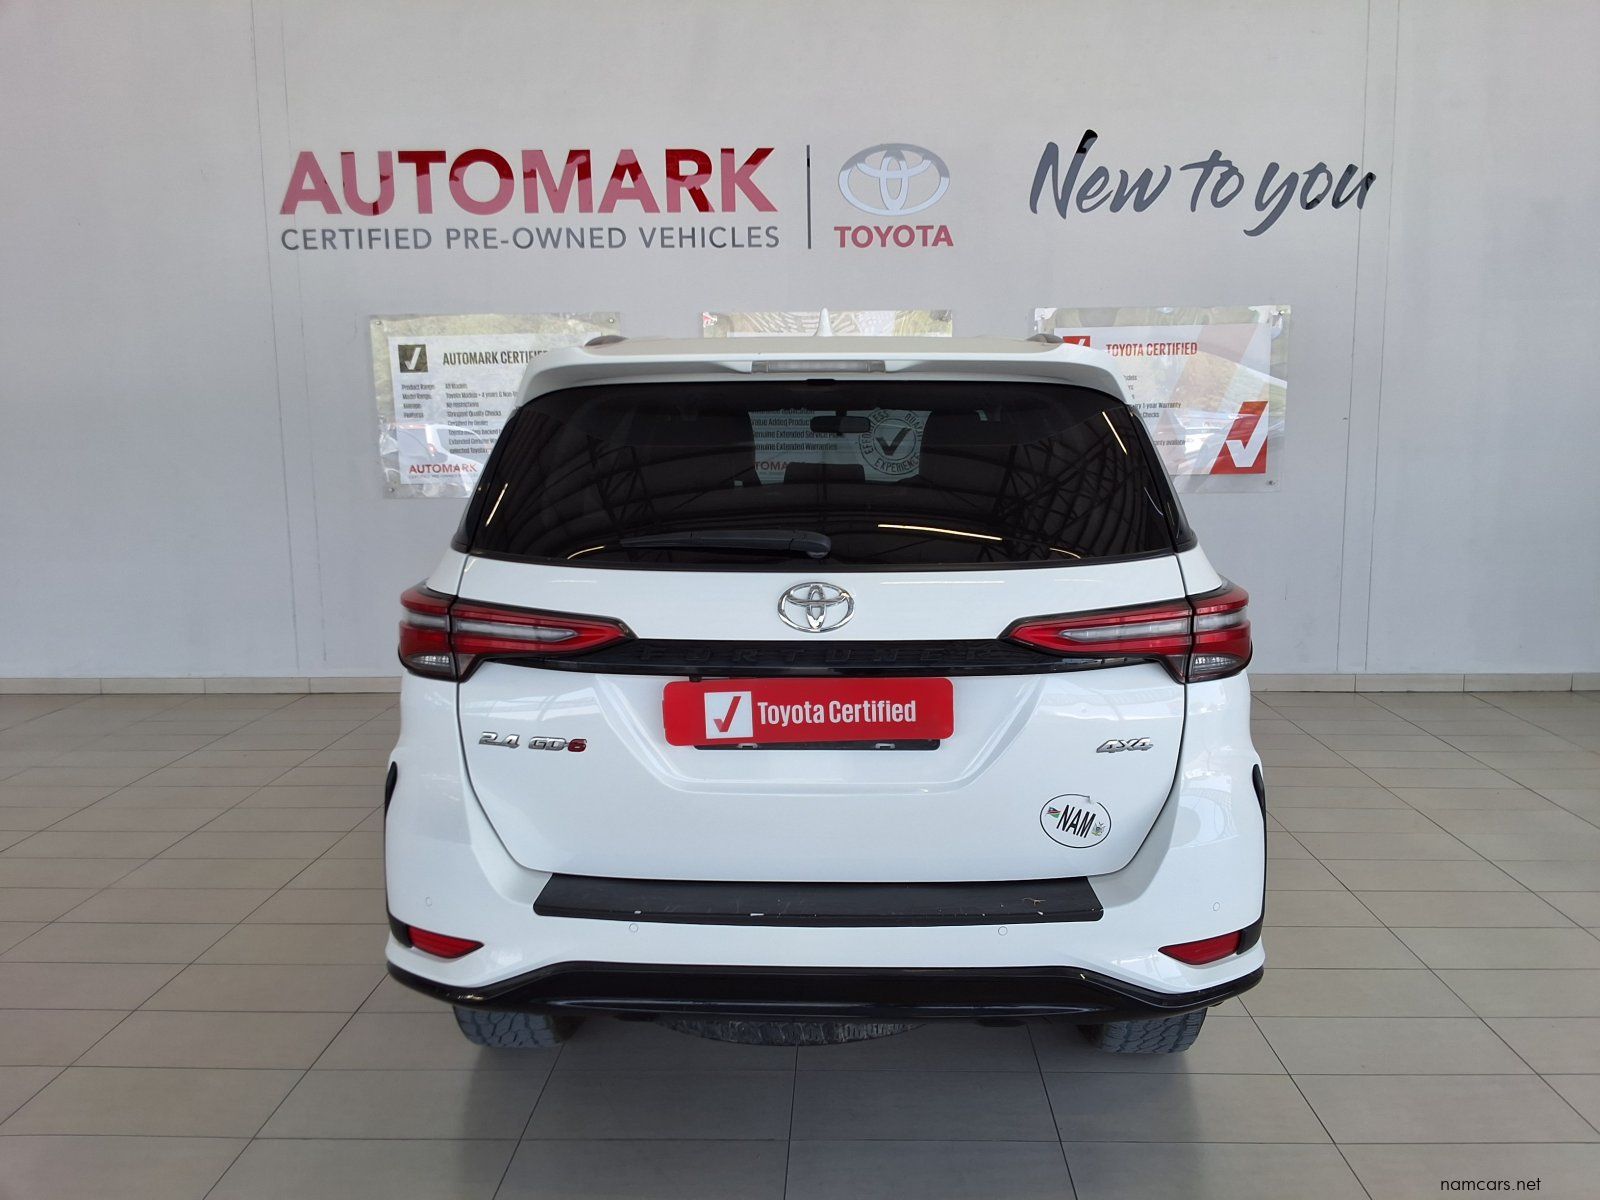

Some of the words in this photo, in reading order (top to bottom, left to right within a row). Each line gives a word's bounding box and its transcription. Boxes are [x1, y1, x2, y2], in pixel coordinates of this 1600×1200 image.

[280, 148, 778, 216] AUTOMARK
[1029, 129, 1172, 219] New
[1179, 149, 1245, 213] to
[1243, 162, 1377, 237] you
[281, 228, 432, 250] CERTIFIED
[446, 227, 626, 250] PRE-OWNED
[638, 226, 780, 249] VEHICLES
[834, 225, 954, 248] TOYOTA
[443, 351, 498, 365] AUTOMARK
[500, 350, 548, 364] CERTIF
[1106, 343, 1144, 357] TOYOTA
[1146, 342, 1198, 355] CERTIFIED
[788, 418, 810, 426] Produc
[755, 443, 776, 451] enuine
[409, 463, 478, 474] AUTOMARK
[757, 701, 825, 727] Toyota
[828, 700, 917, 724] Certified
[1056, 804, 1097, 838] NAM
